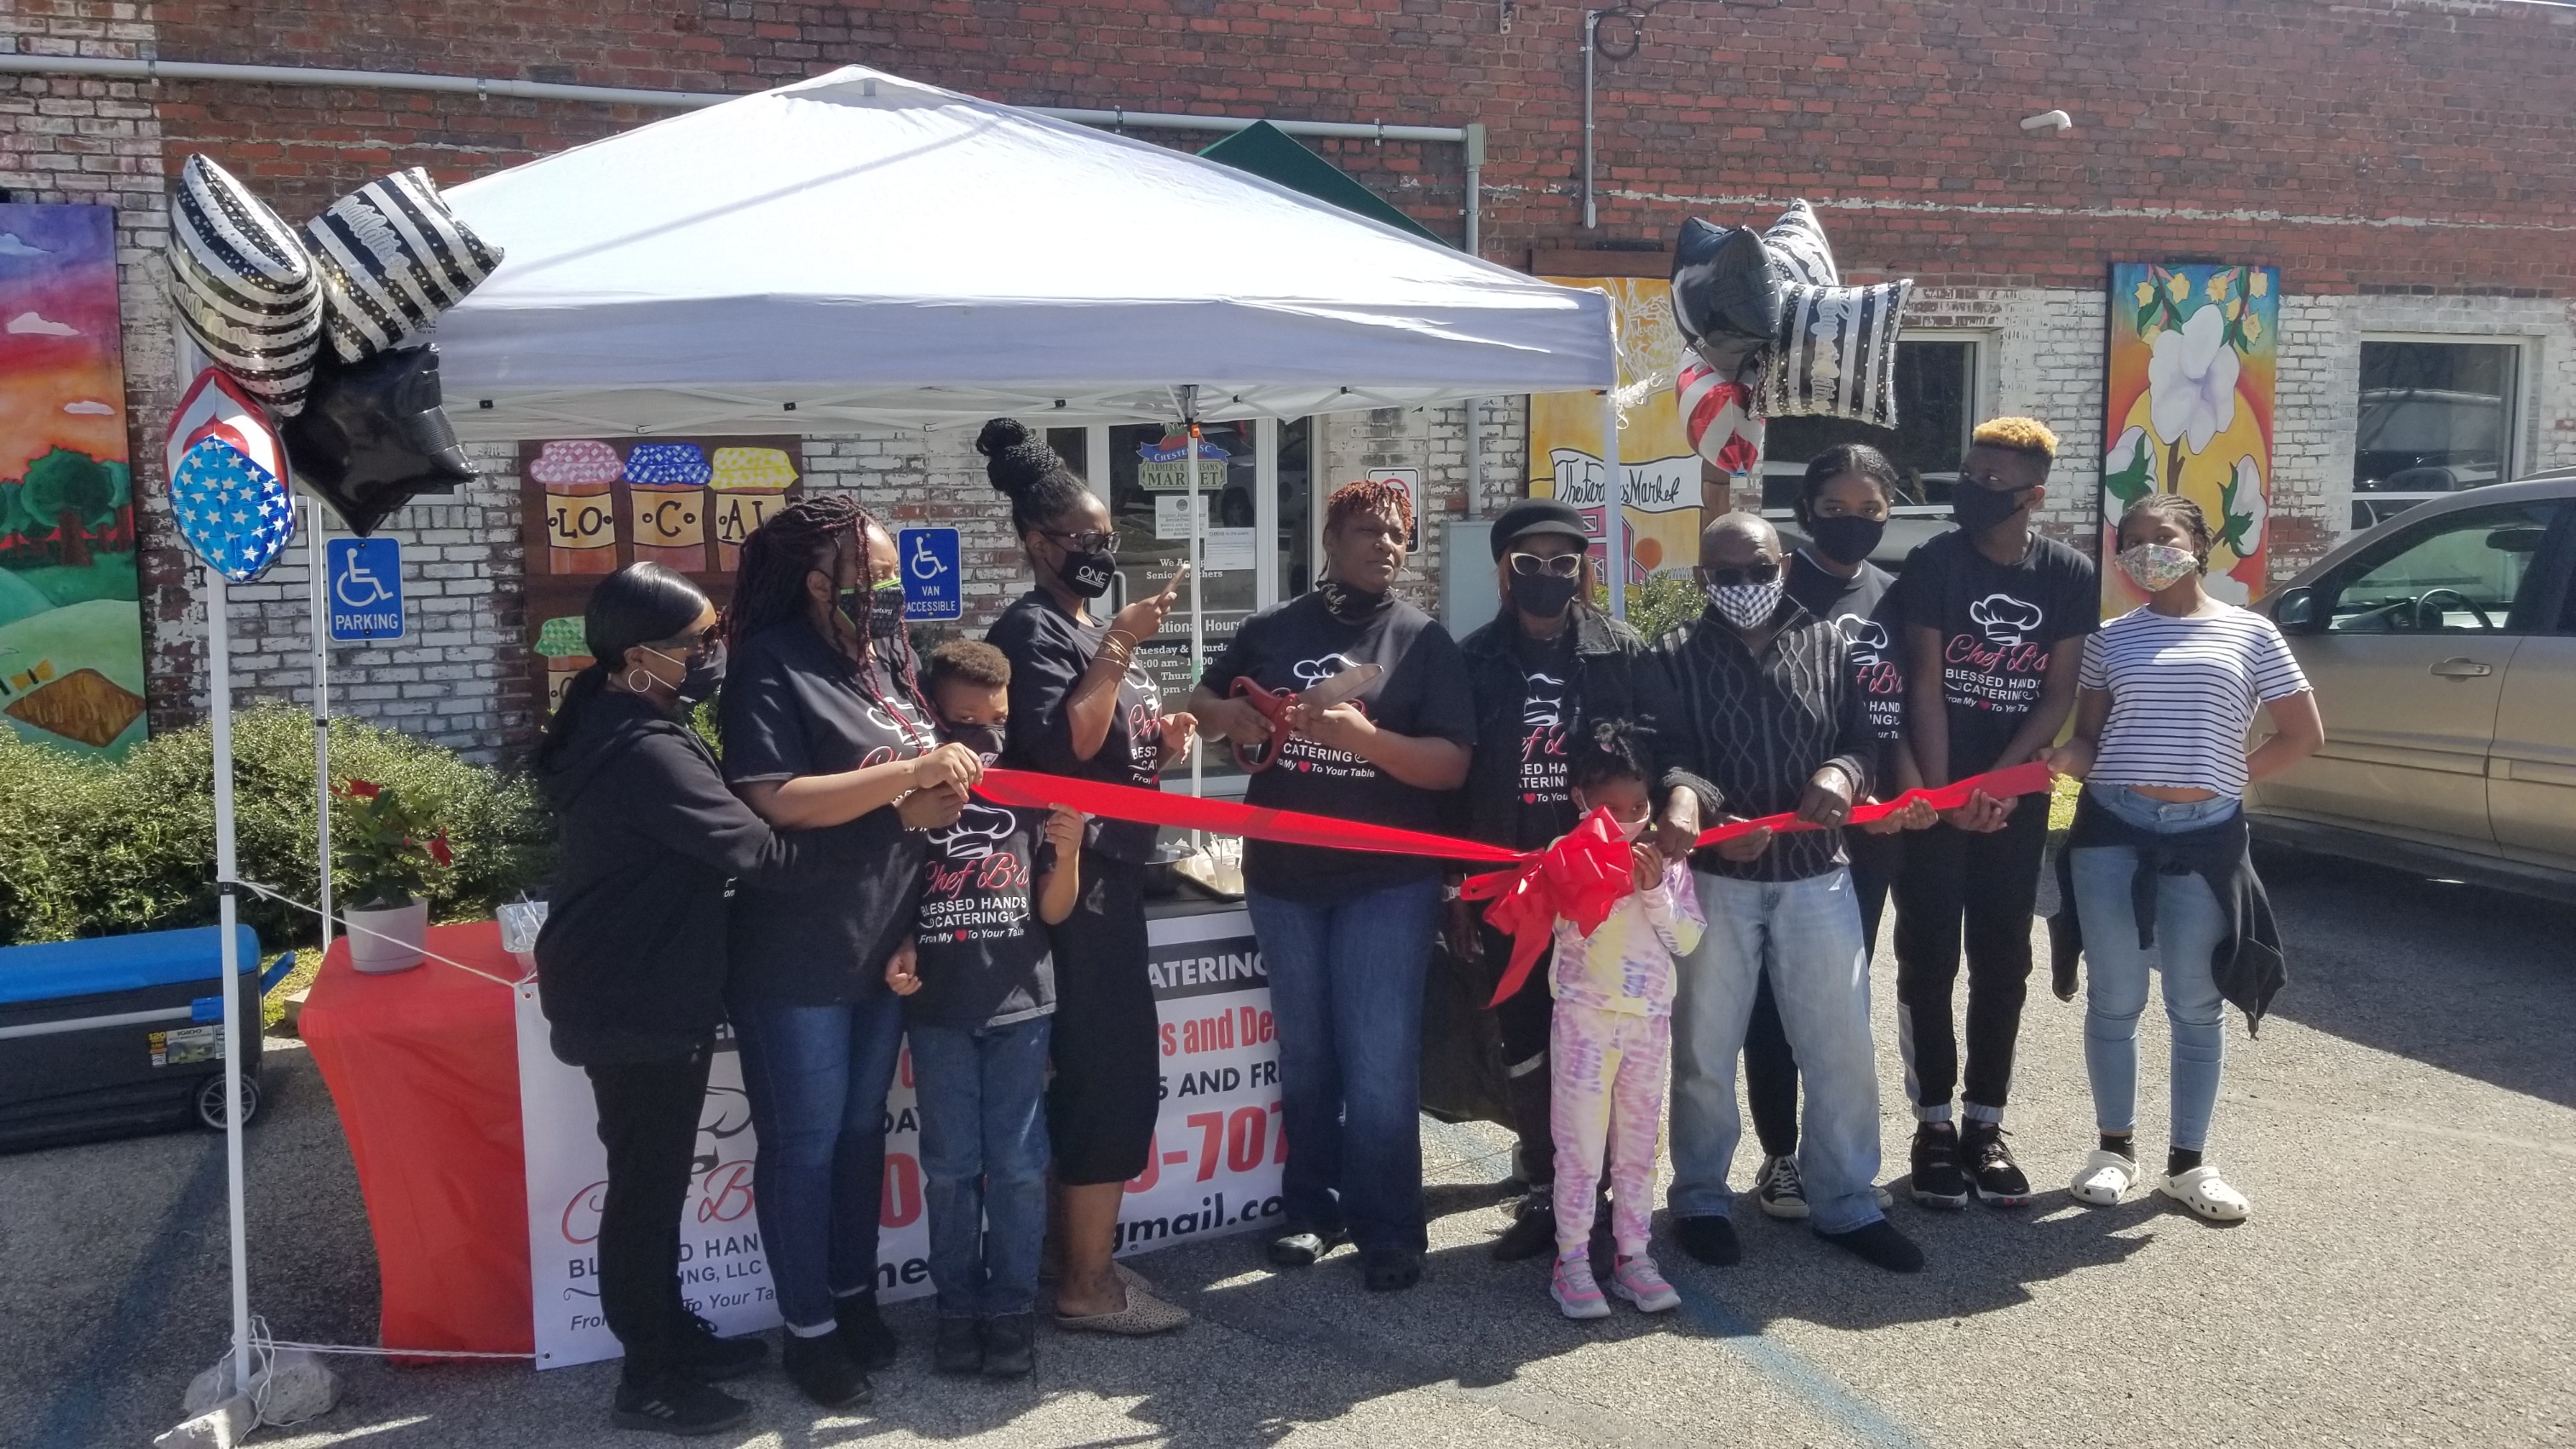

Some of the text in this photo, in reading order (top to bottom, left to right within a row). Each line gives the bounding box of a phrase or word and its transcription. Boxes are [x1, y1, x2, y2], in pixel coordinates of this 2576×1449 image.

[1154, 444, 1211, 462] CHESTE SC
[1147, 472, 1218, 486] MARET
[1159, 558, 1175, 566] We
[1078, 565, 1109, 585] ONE
[922, 586, 940, 596] VAN
[906, 601, 956, 612] ACCESSIBLE
[335, 613, 399, 630] PARKING
[1133, 645, 1177, 656] Tuesday
[1180, 644, 1188, 653] &
[1946, 634, 2007, 674] Chef
[1160, 671, 1192, 681] Thurs
[1945, 668, 2004, 687] BLESSED
[1162, 687, 1181, 696] pm
[1869, 701, 1900, 713] HAND
[1963, 698, 1977, 708] My
[1991, 703, 2003, 712] To
[1283, 742, 1353, 762] CATERING
[1312, 762, 1323, 773] To
[1325, 765, 1348, 778] Your
[1350, 768, 1375, 778] Table
[1537, 792, 1568, 802] To You
[923, 852, 1029, 899] Chef B's
[921, 896, 1026, 917] BLESSED HANDS
[934, 911, 1009, 928] CATERING
[938, 933, 953, 944] My
[968, 929, 978, 939] To
[981, 929, 1005, 939] Your
[1148, 952, 1269, 989] ATERIN
[1183, 1008, 1233, 1055] and
[1178, 1067, 1240, 1098] AND
[705, 1233, 758, 1259] HAN
[727, 1259, 762, 1279] LLC
[709, 1292, 750, 1310] Your
